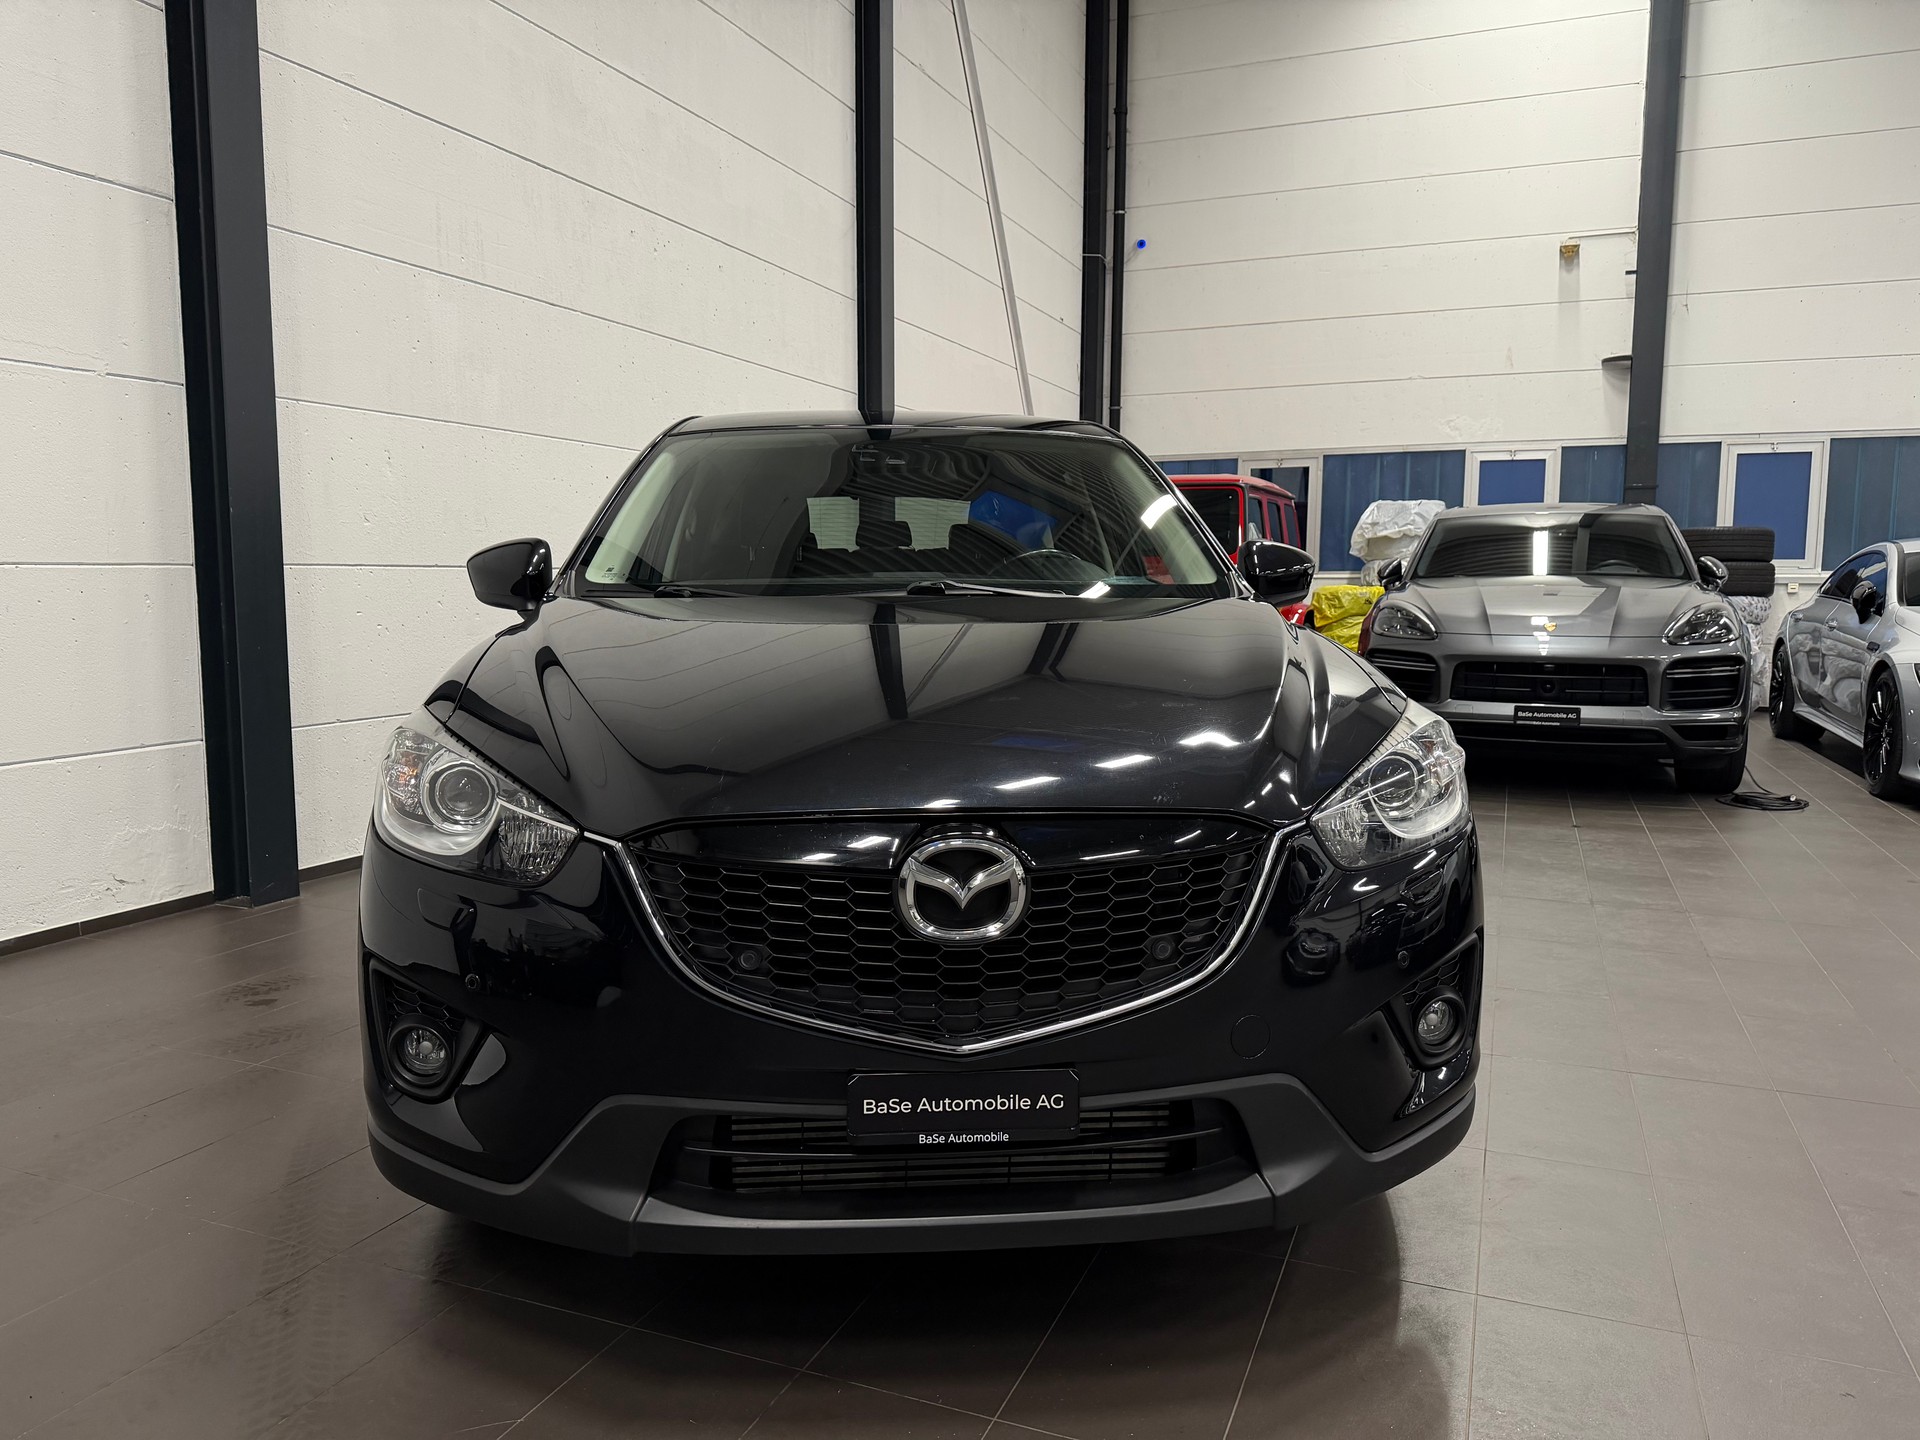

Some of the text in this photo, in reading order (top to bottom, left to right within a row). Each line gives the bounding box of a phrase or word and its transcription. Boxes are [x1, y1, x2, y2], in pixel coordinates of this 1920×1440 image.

[863, 1093, 1064, 1115] BaSe Automobile AG
[918, 1131, 1010, 1144] BaSe Automobile
